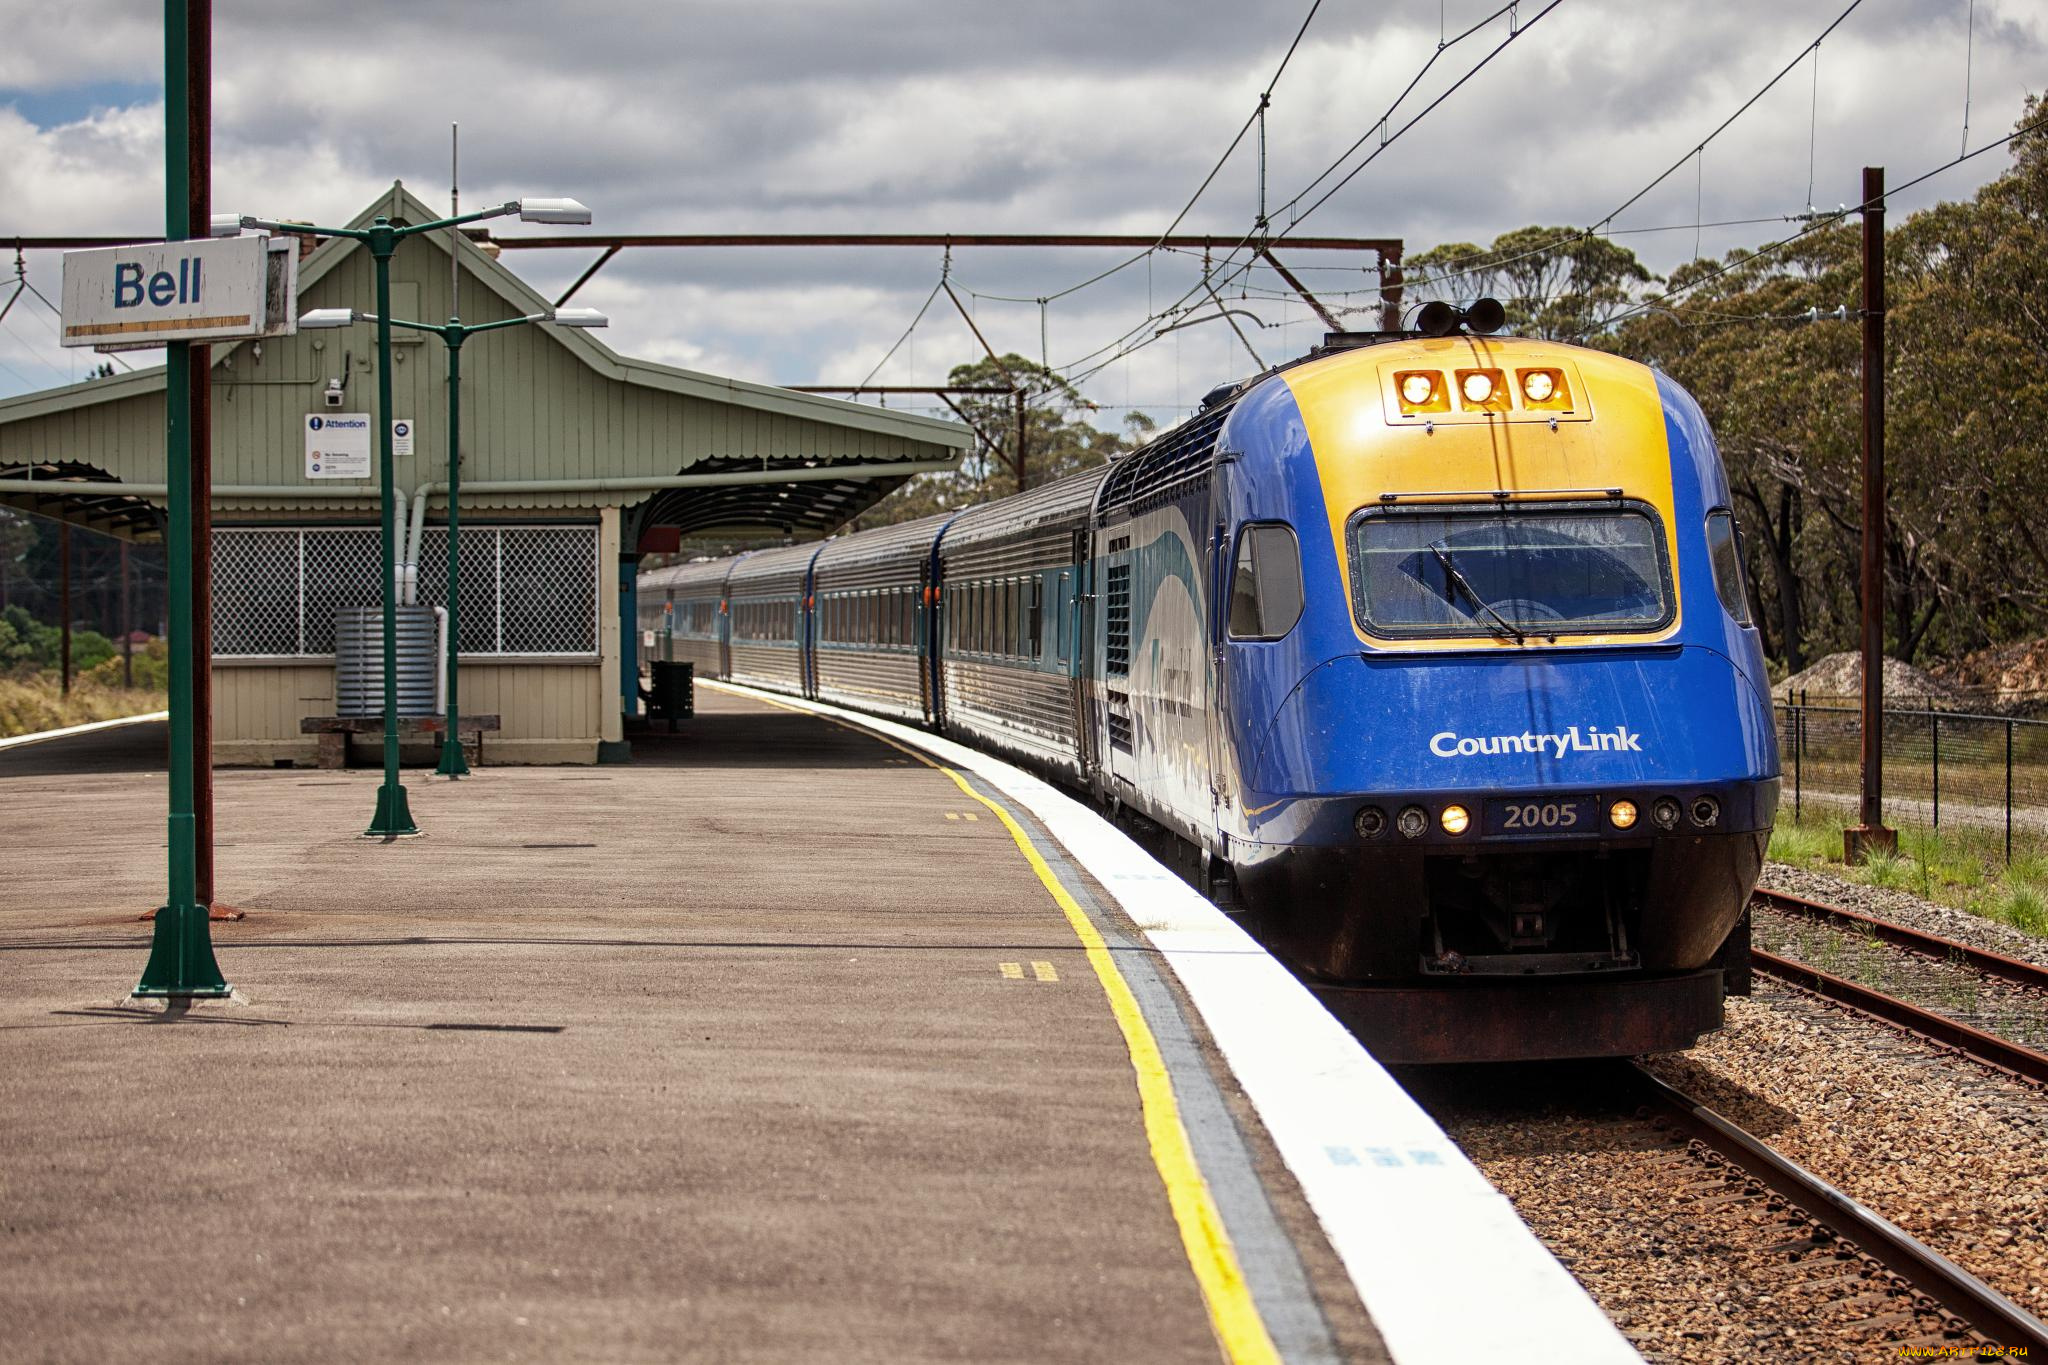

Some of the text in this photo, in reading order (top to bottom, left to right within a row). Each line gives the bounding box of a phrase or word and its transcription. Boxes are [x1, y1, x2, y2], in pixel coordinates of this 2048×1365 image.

[114, 257, 202, 309] Bell
[325, 419, 366, 428] Attention
[1429, 726, 1643, 759] CountryLink
[1503, 803, 1577, 829] 2005
